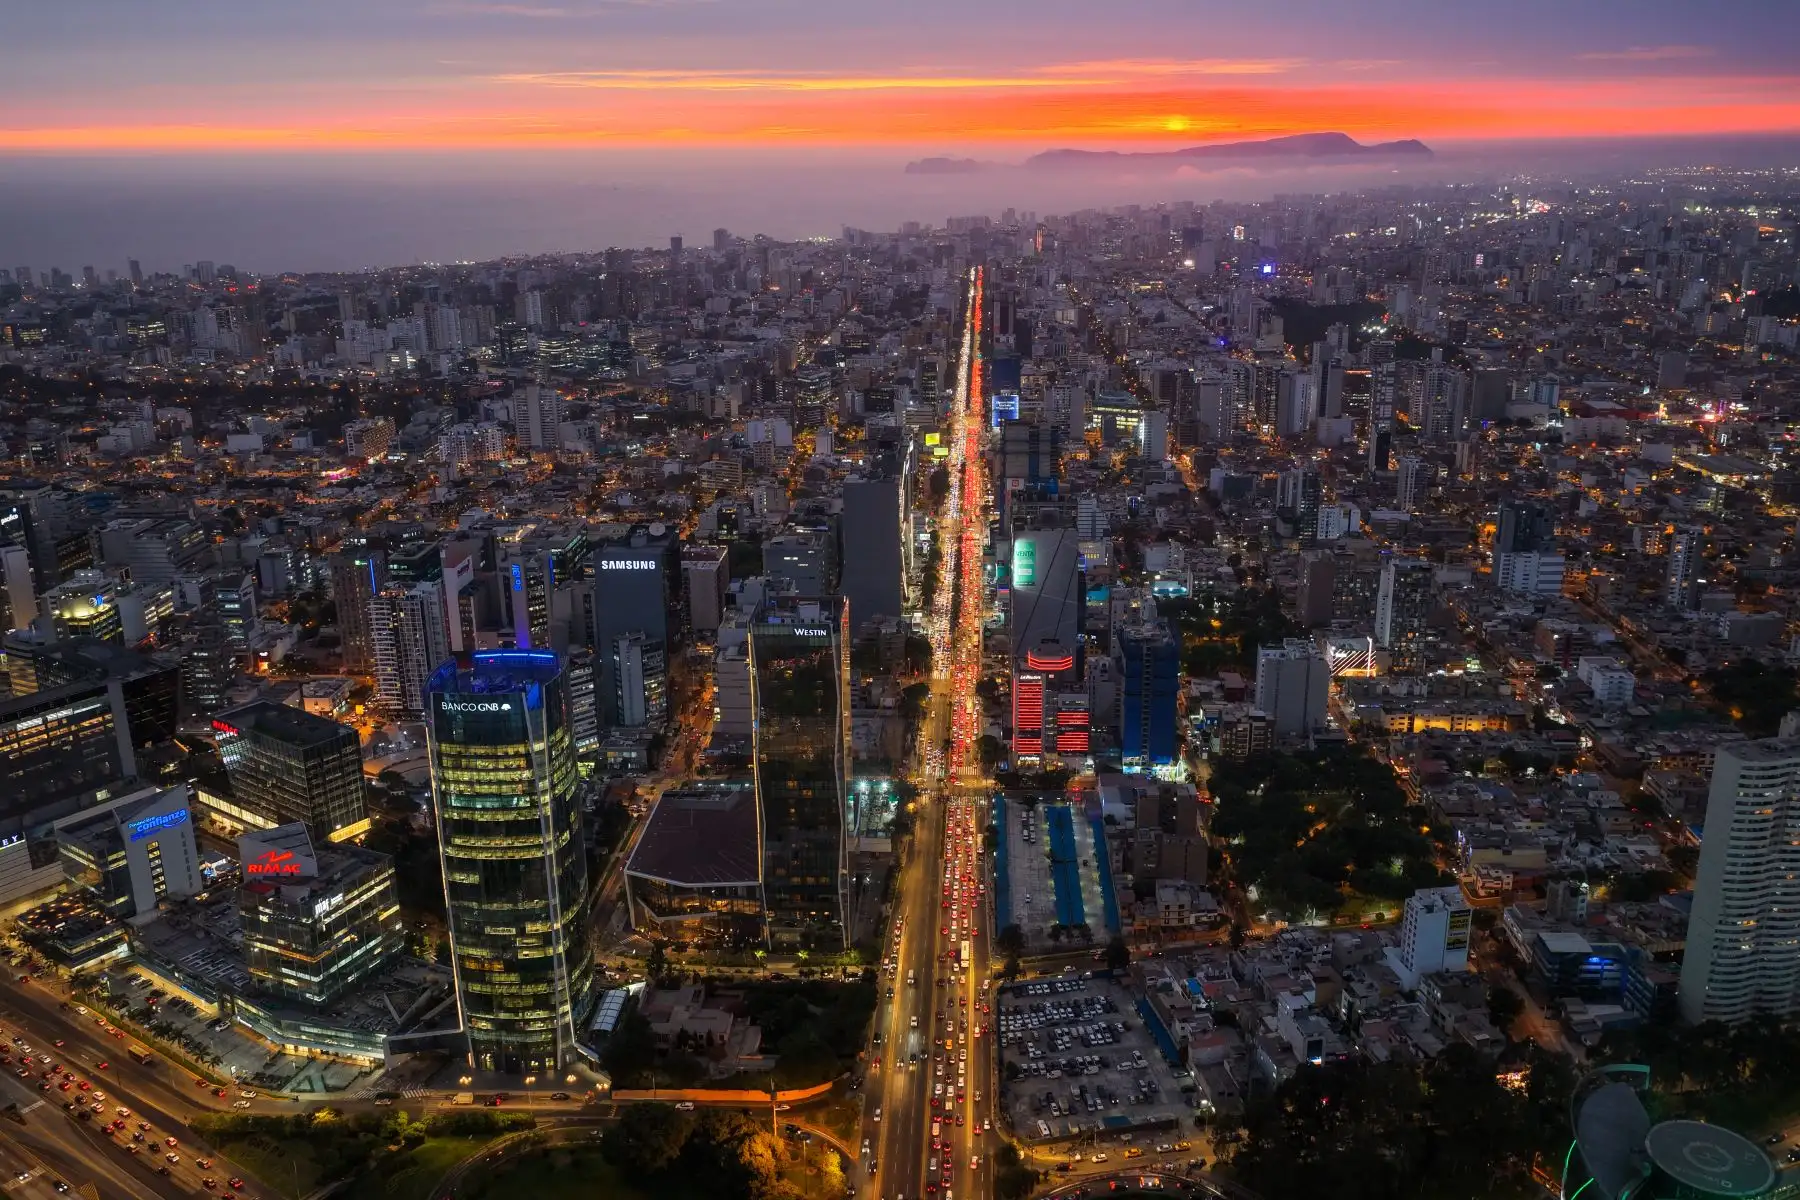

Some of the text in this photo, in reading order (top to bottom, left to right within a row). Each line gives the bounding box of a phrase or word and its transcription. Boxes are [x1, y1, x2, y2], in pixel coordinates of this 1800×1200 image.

[601, 560, 656, 570] SAMSUNG
[441, 702, 499, 712] BANCO GNB
[137, 808, 186, 832] confianza
[248, 863, 301, 873] RIMAC
